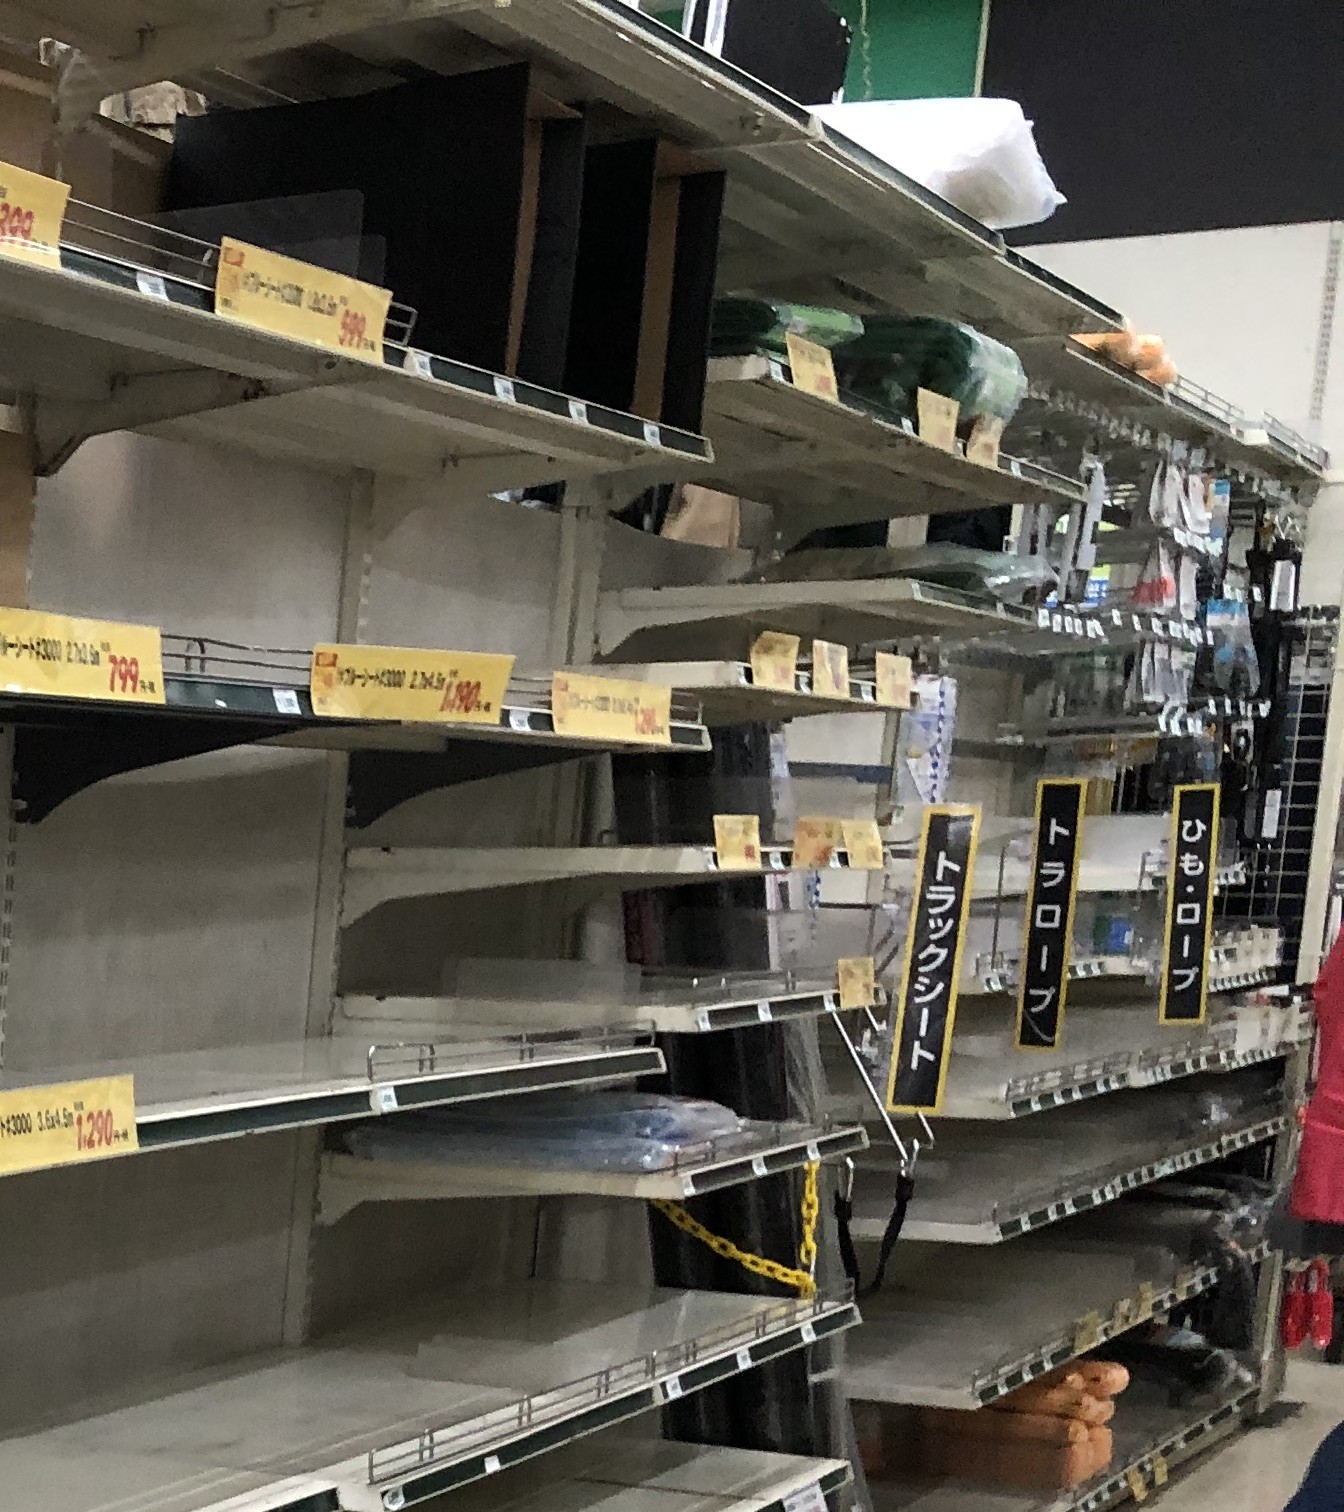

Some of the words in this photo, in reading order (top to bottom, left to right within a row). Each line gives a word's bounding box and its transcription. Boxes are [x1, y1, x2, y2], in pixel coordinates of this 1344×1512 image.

[107, 654, 141, 694] 799
[910, 850, 962, 1072] トラックシート
[1028, 816, 1071, 1014] トラロープ
[1172, 818, 1208, 992] ひも・ロープ
[75, 1109, 114, 1151] 1,290
